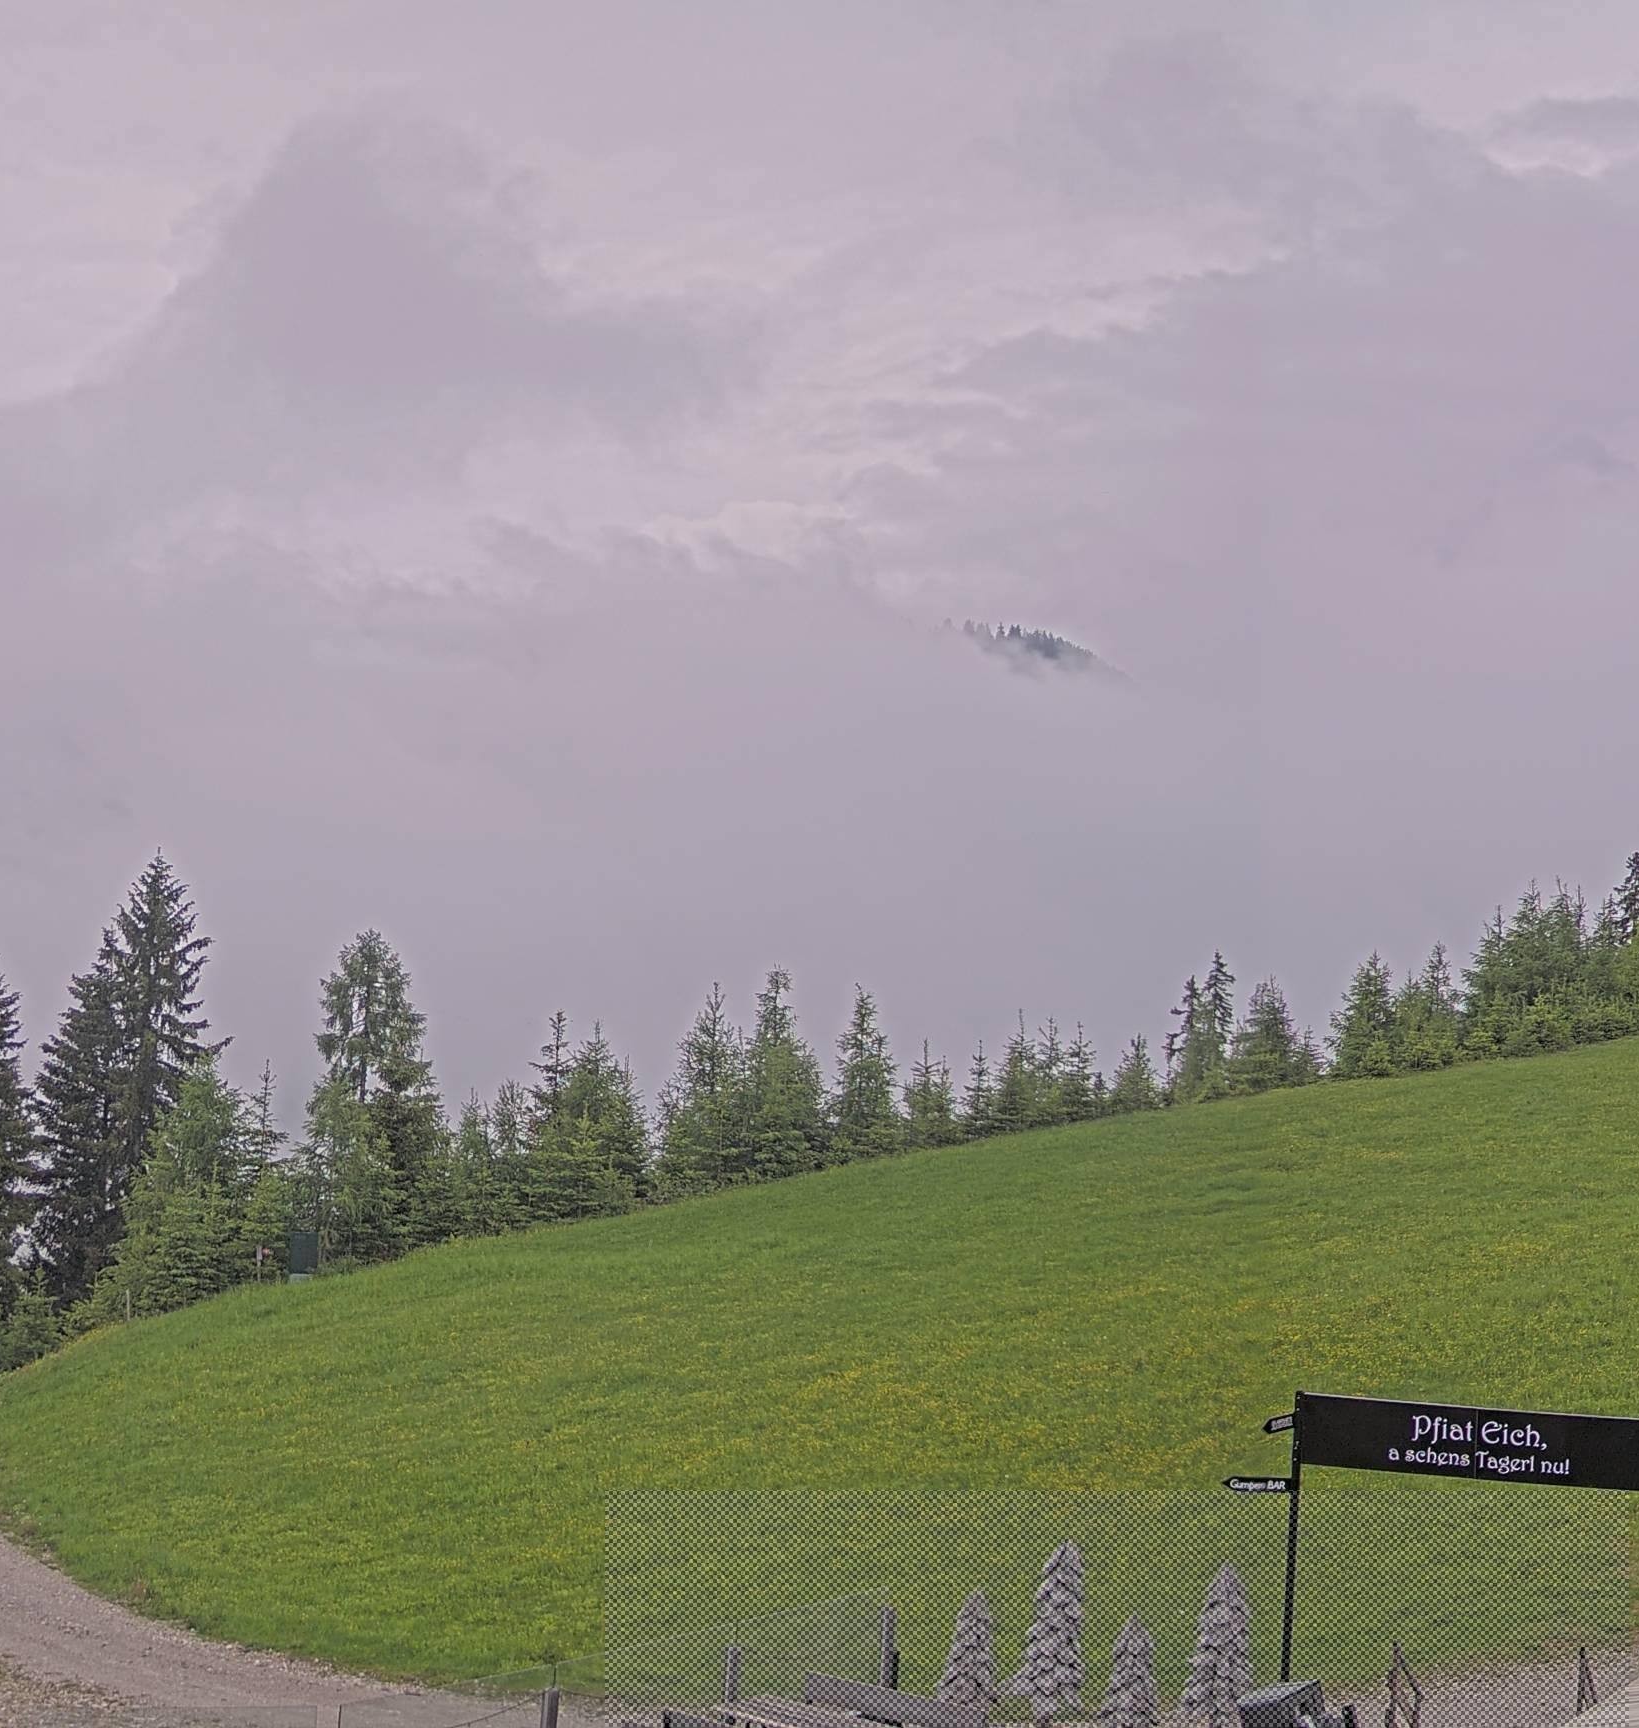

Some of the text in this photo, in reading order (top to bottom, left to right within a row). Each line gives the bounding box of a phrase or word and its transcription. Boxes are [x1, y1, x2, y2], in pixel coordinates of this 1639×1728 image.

[1411, 1415, 1547, 1450] Pfiat Eich,
[1388, 1447, 1570, 1475] a schens Tagerl nu!
[1267, 1480, 1286, 1490] BAR
